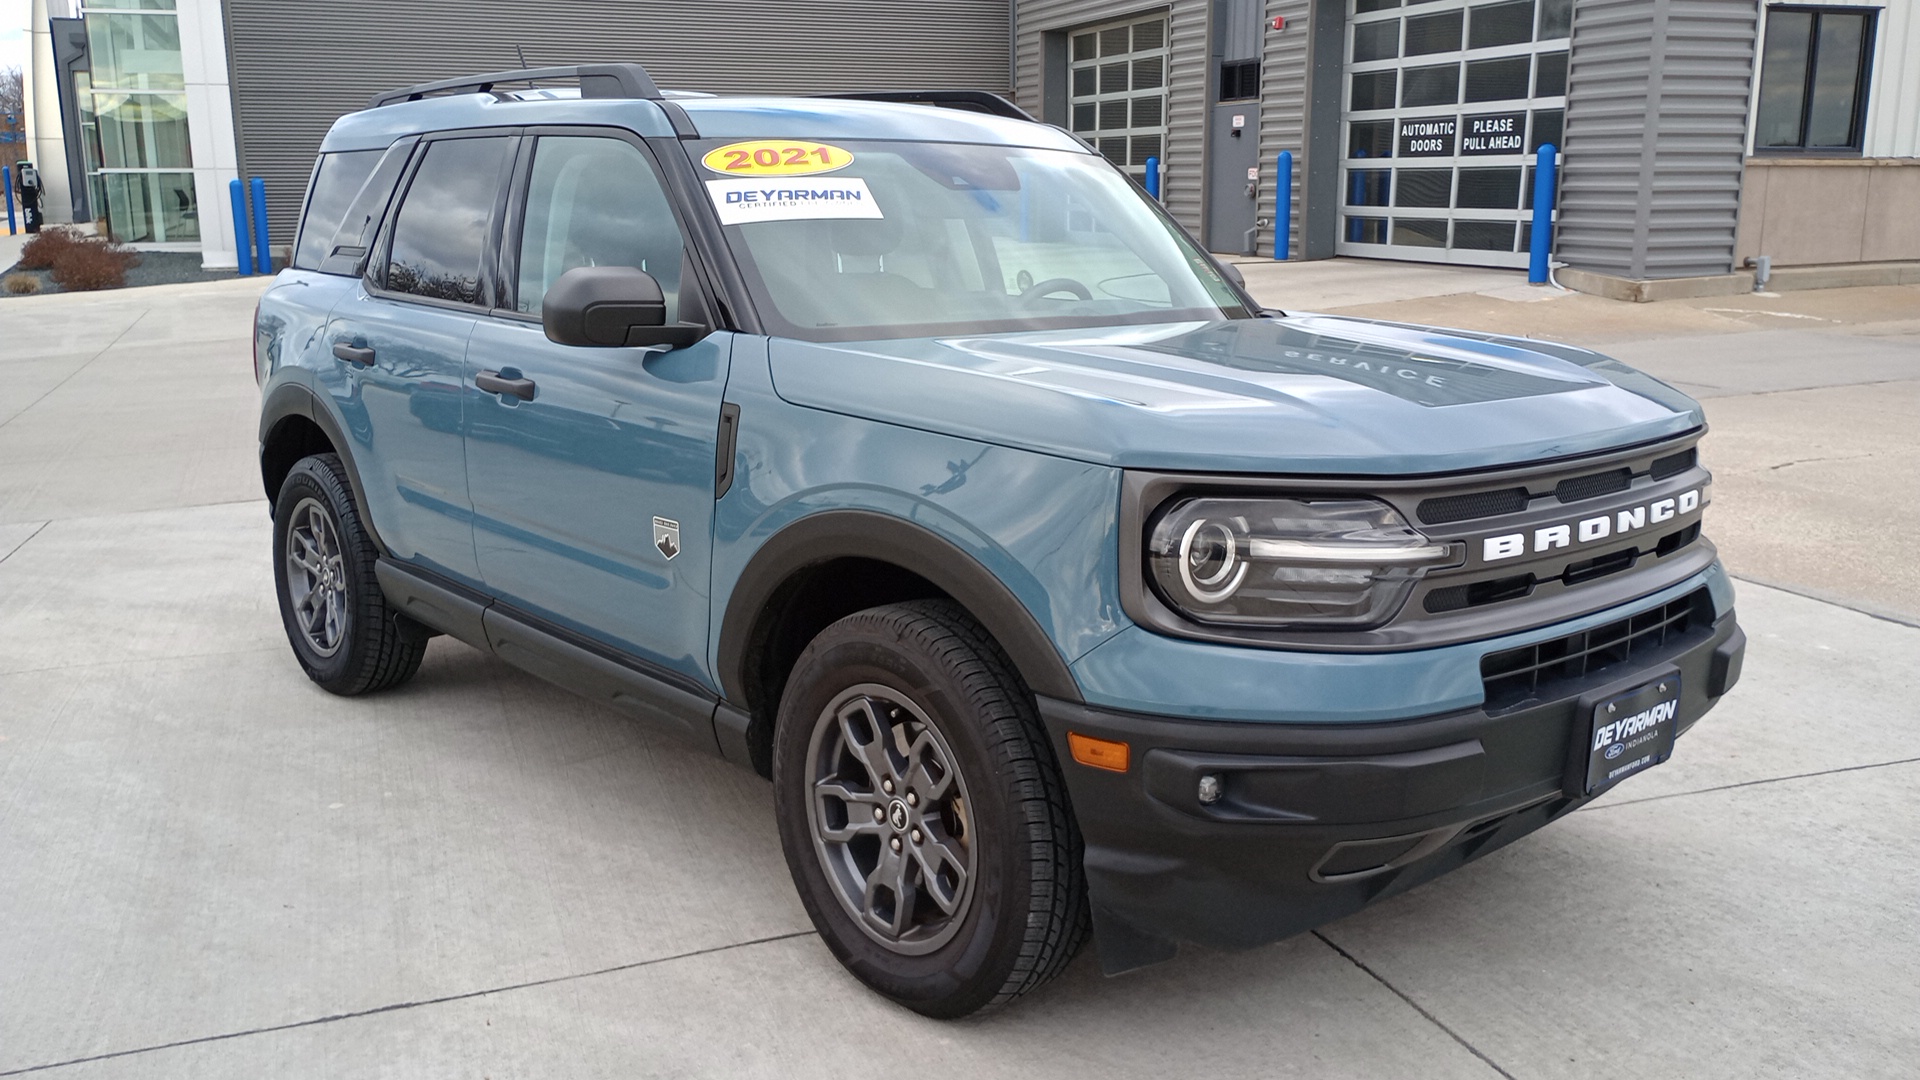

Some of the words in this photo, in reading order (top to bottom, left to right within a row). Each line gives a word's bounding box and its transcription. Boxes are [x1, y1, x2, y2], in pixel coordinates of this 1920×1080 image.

[1401, 122, 1454, 136] AUTOMATIC
[1473, 119, 1513, 133] PLEASE
[1410, 139, 1442, 151] DOORS
[1463, 137, 1486, 150] PULL
[1488, 136, 1521, 149] AHEAD
[724, 147, 833, 170] 2021
[726, 189, 861, 204] DEYARMAN
[739, 201, 797, 209] CERTIFIED
[1482, 489, 1699, 562] BRONCO
[1593, 699, 1678, 752] DEYARMAN
[1625, 729, 1659, 750] INDIANOLA
